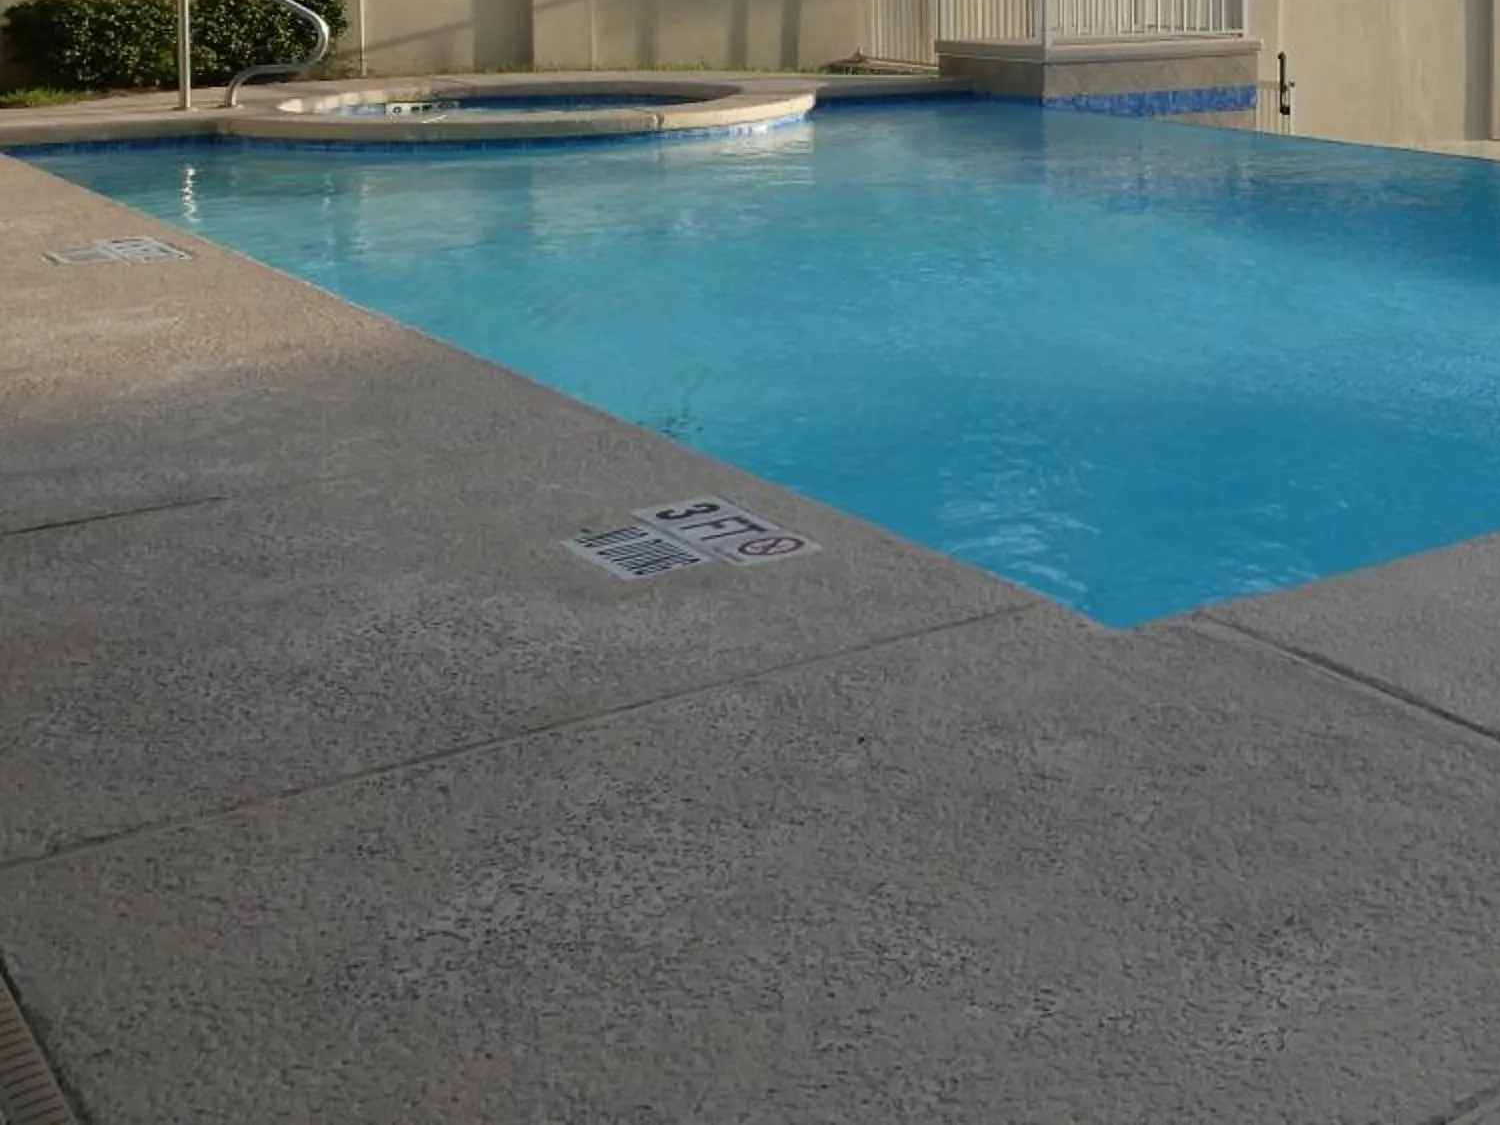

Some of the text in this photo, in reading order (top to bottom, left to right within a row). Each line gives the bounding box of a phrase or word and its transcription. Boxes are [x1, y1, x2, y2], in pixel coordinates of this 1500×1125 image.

[656, 502, 768, 541] 3 FT
[573, 526, 701, 575] NO DIVING
